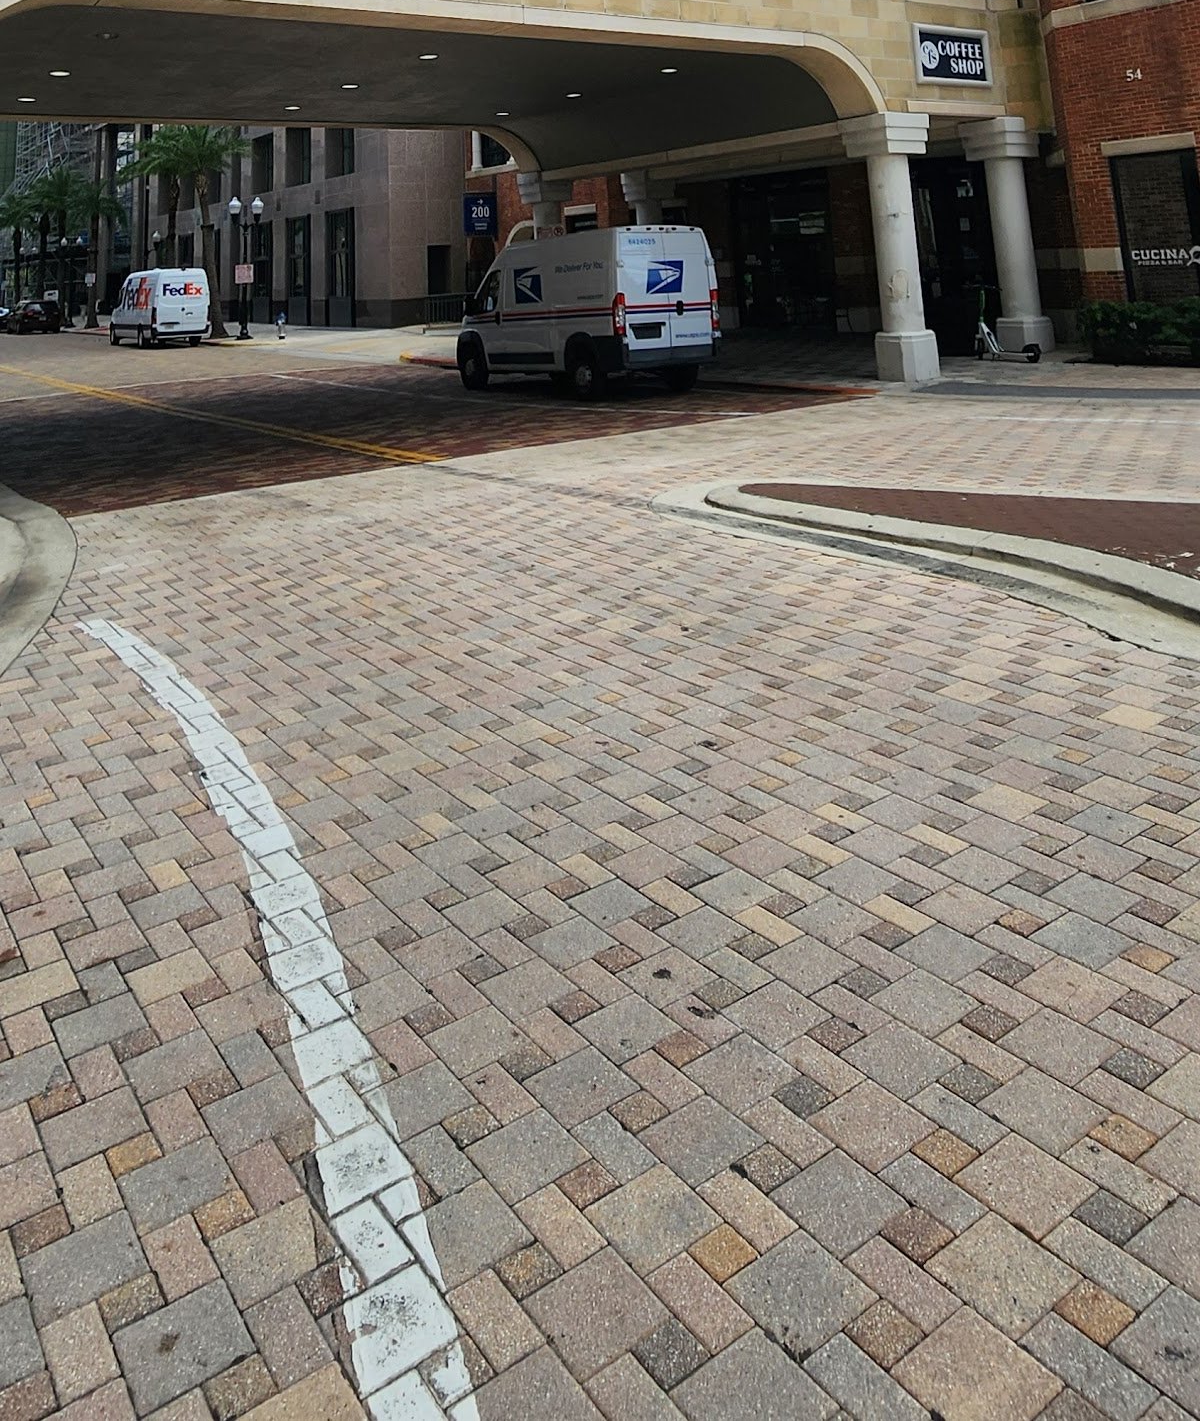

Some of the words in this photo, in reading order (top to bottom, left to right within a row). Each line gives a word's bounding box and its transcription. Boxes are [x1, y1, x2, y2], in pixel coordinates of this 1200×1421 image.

[938, 40, 983, 60] COFFEE
[950, 58, 984, 75] SHOP
[1126, 68, 1142, 81] 54
[472, 206, 489, 218] 200
[1131, 248, 1189, 260] CUCINA
[123, 277, 152, 311] FedEx
[163, 283, 203, 296] FedEx
